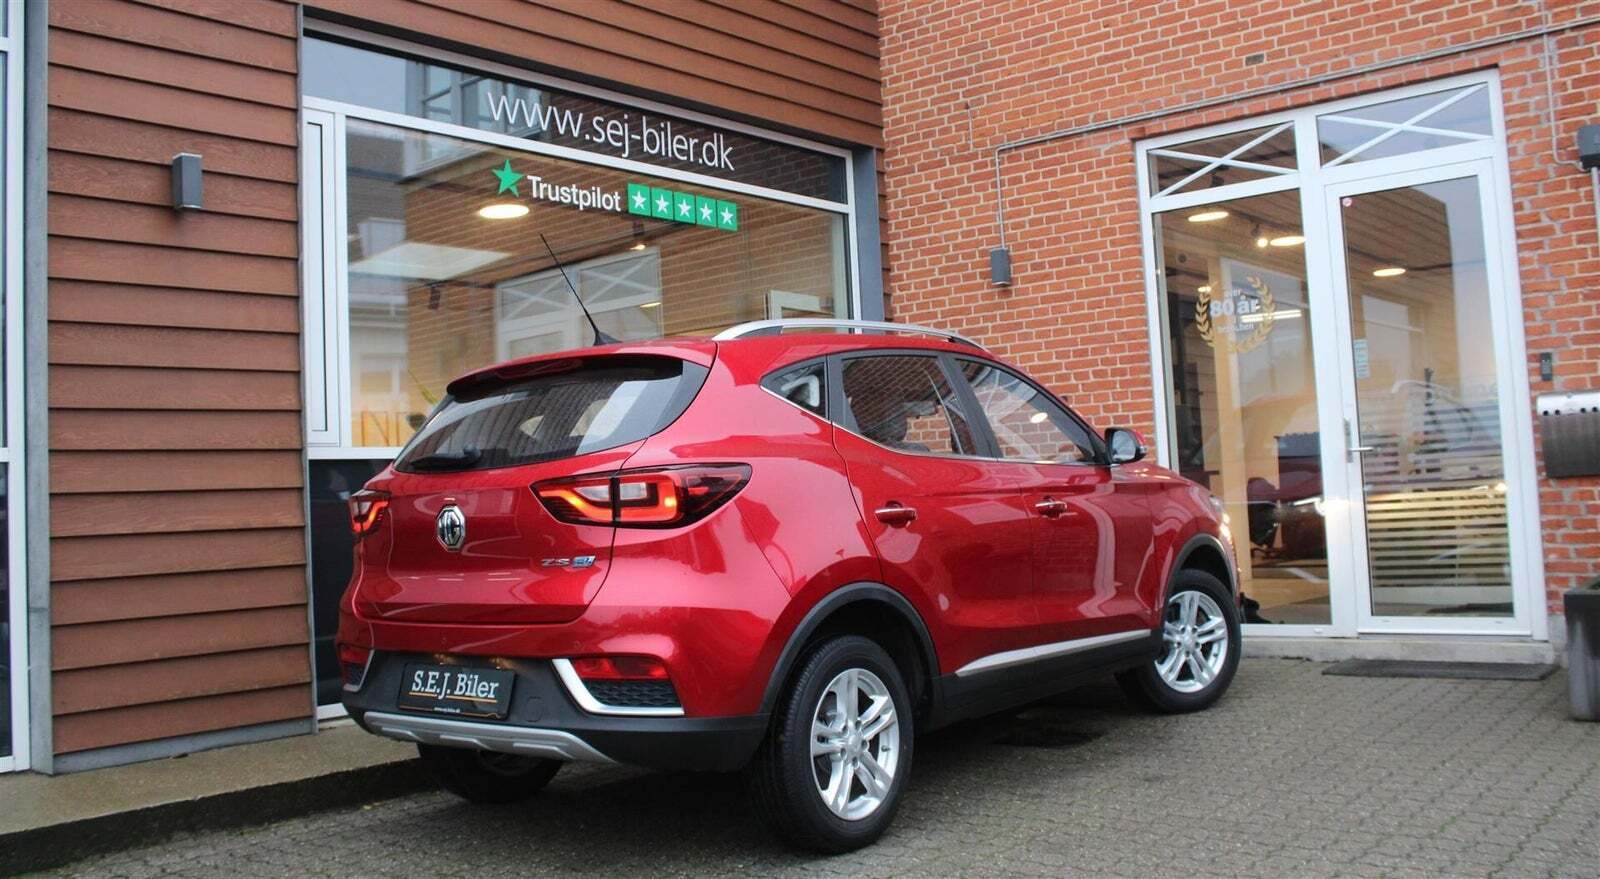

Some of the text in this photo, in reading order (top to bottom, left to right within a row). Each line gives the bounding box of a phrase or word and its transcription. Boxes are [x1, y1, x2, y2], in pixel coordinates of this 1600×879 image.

[488, 92, 735, 171] www.sej-biler.dk
[527, 174, 621, 212] Trustpilot
[1210, 295, 1260, 317] 80 år
[411, 670, 499, 699] S.E.J. Biler
